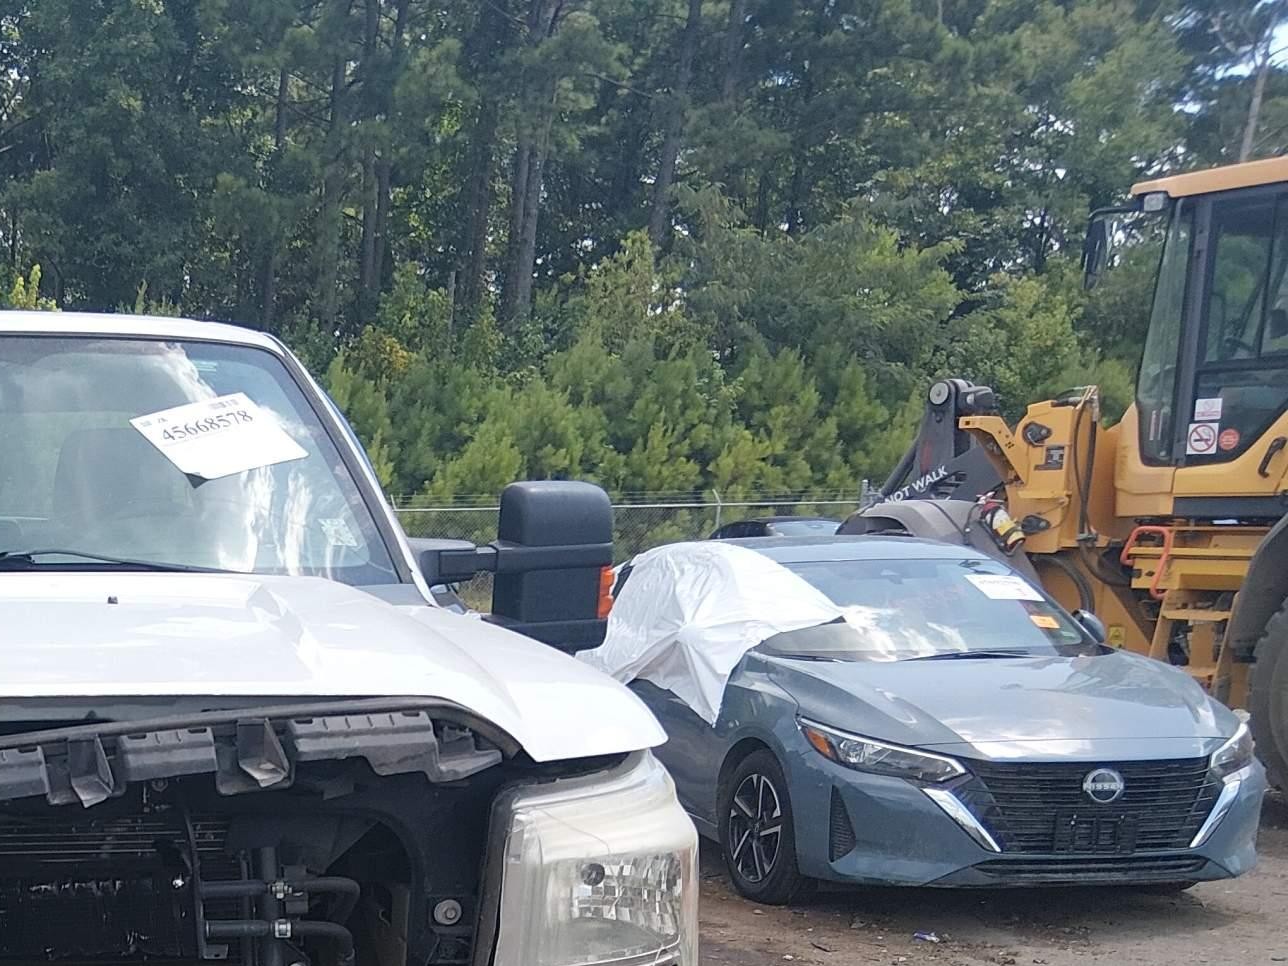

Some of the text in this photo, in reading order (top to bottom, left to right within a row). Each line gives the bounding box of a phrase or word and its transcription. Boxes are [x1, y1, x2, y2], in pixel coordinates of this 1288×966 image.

[162, 410, 254, 441] 45668578
[884, 465, 949, 504] NOT WALK
